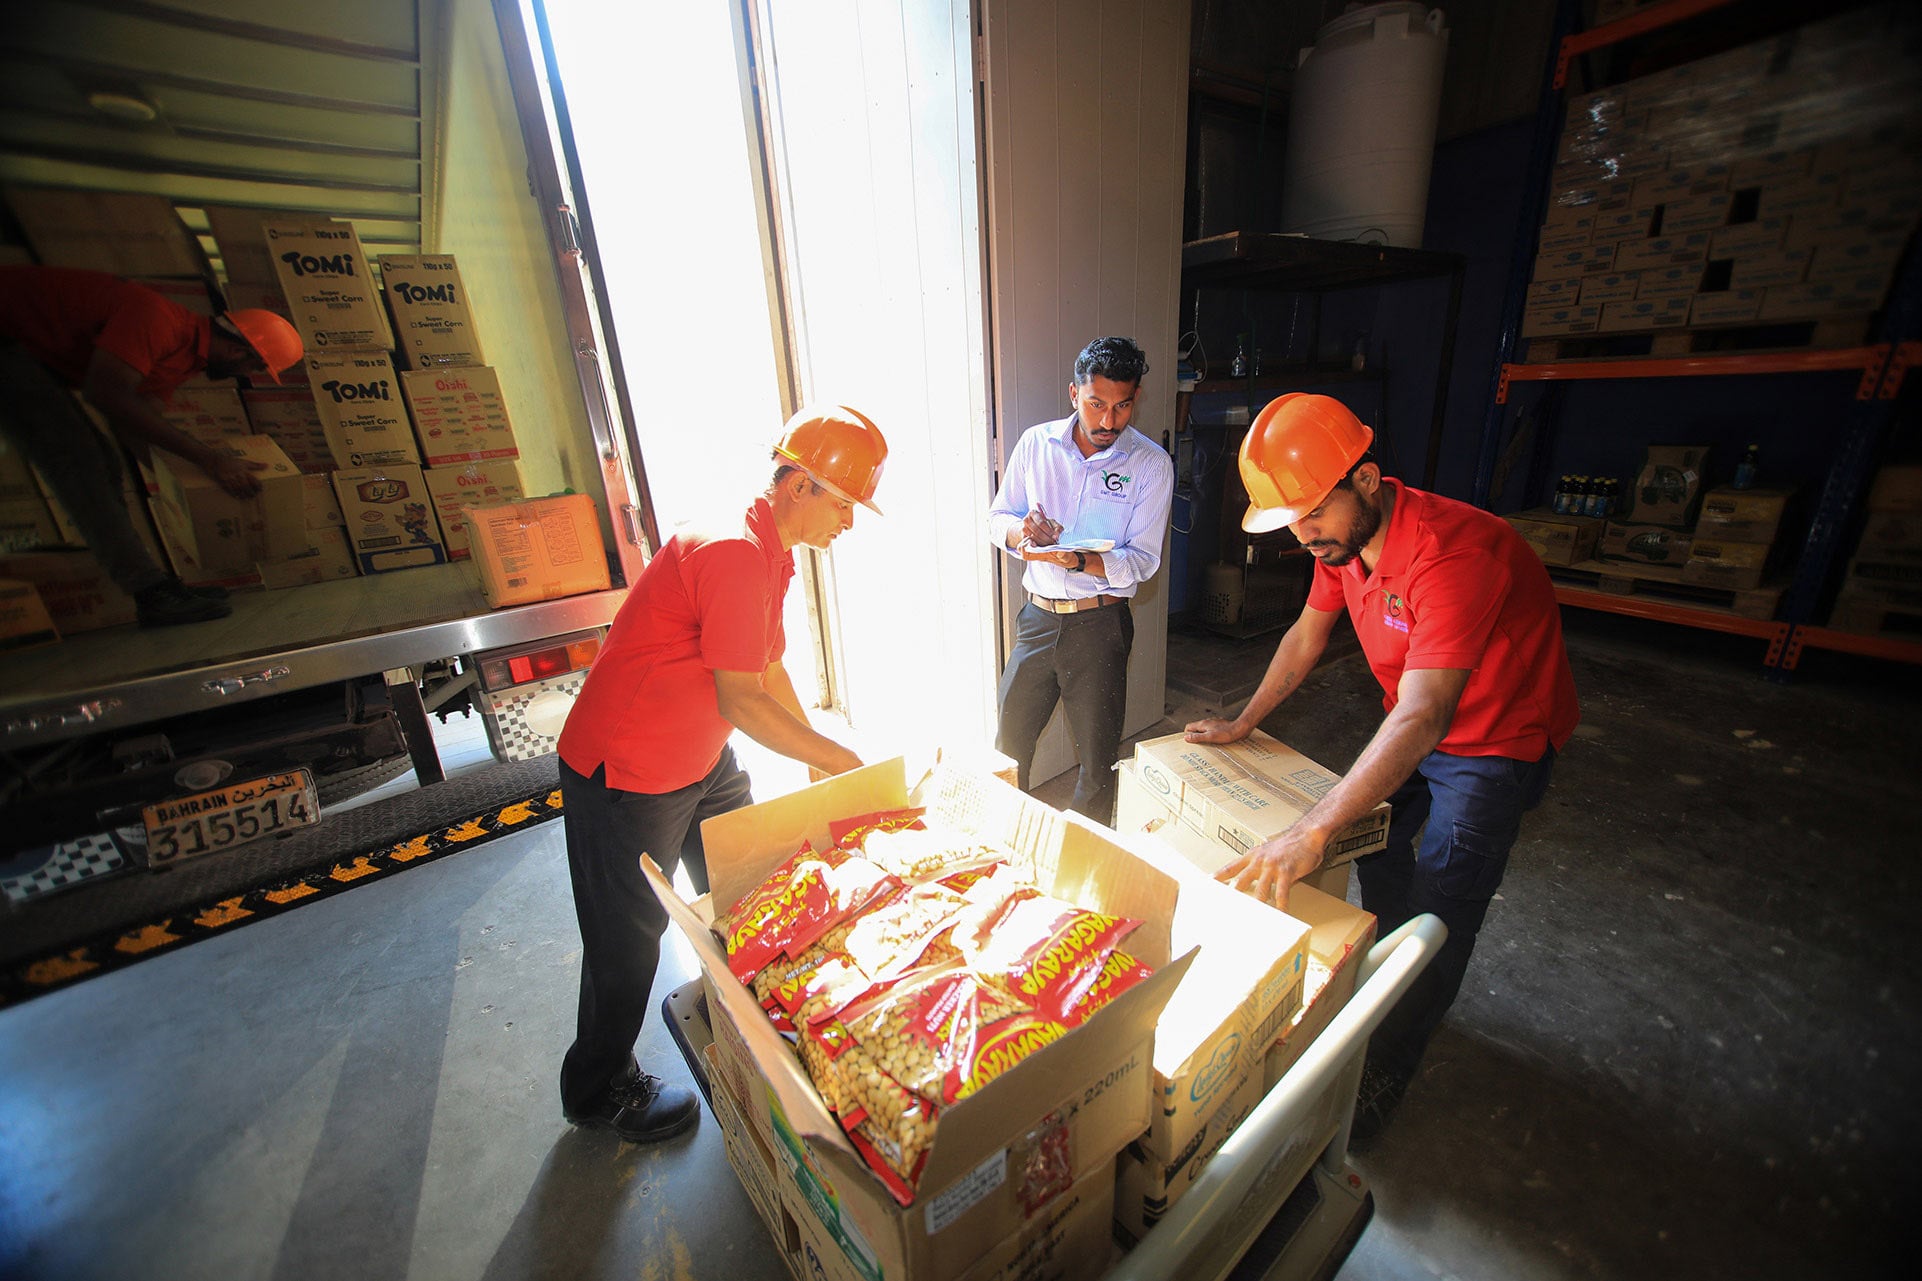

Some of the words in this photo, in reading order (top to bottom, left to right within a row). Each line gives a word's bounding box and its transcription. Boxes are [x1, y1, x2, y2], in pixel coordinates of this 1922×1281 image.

[158, 795, 228, 824] BAHRAIN
[232, 776, 296, 803] البحرين
[152, 794, 308, 861] 315514
[1084, 1055, 1140, 1107] 220mL
